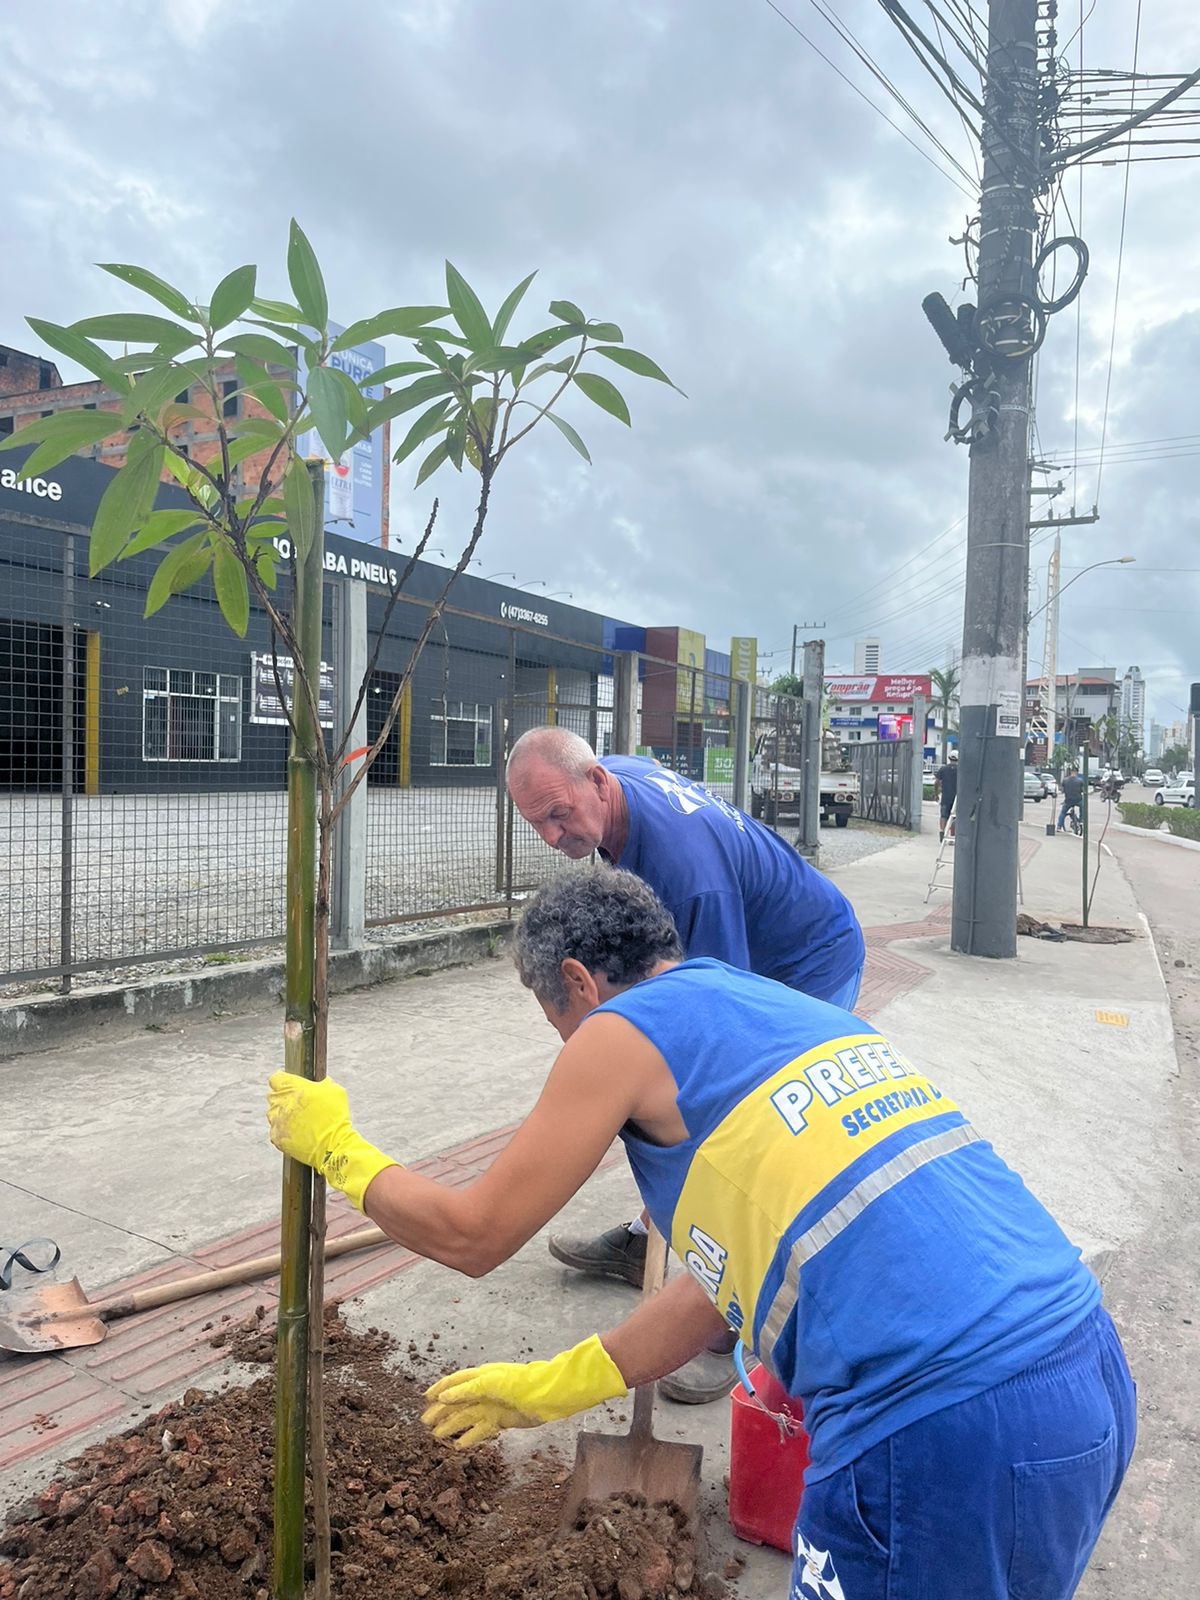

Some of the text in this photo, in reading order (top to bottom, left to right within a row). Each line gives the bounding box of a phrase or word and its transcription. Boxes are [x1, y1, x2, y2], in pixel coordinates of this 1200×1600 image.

[351, 558, 397, 586] PNEUS
[841, 1086, 932, 1137] SECRETARIA
[685, 1223, 728, 1306] RA
